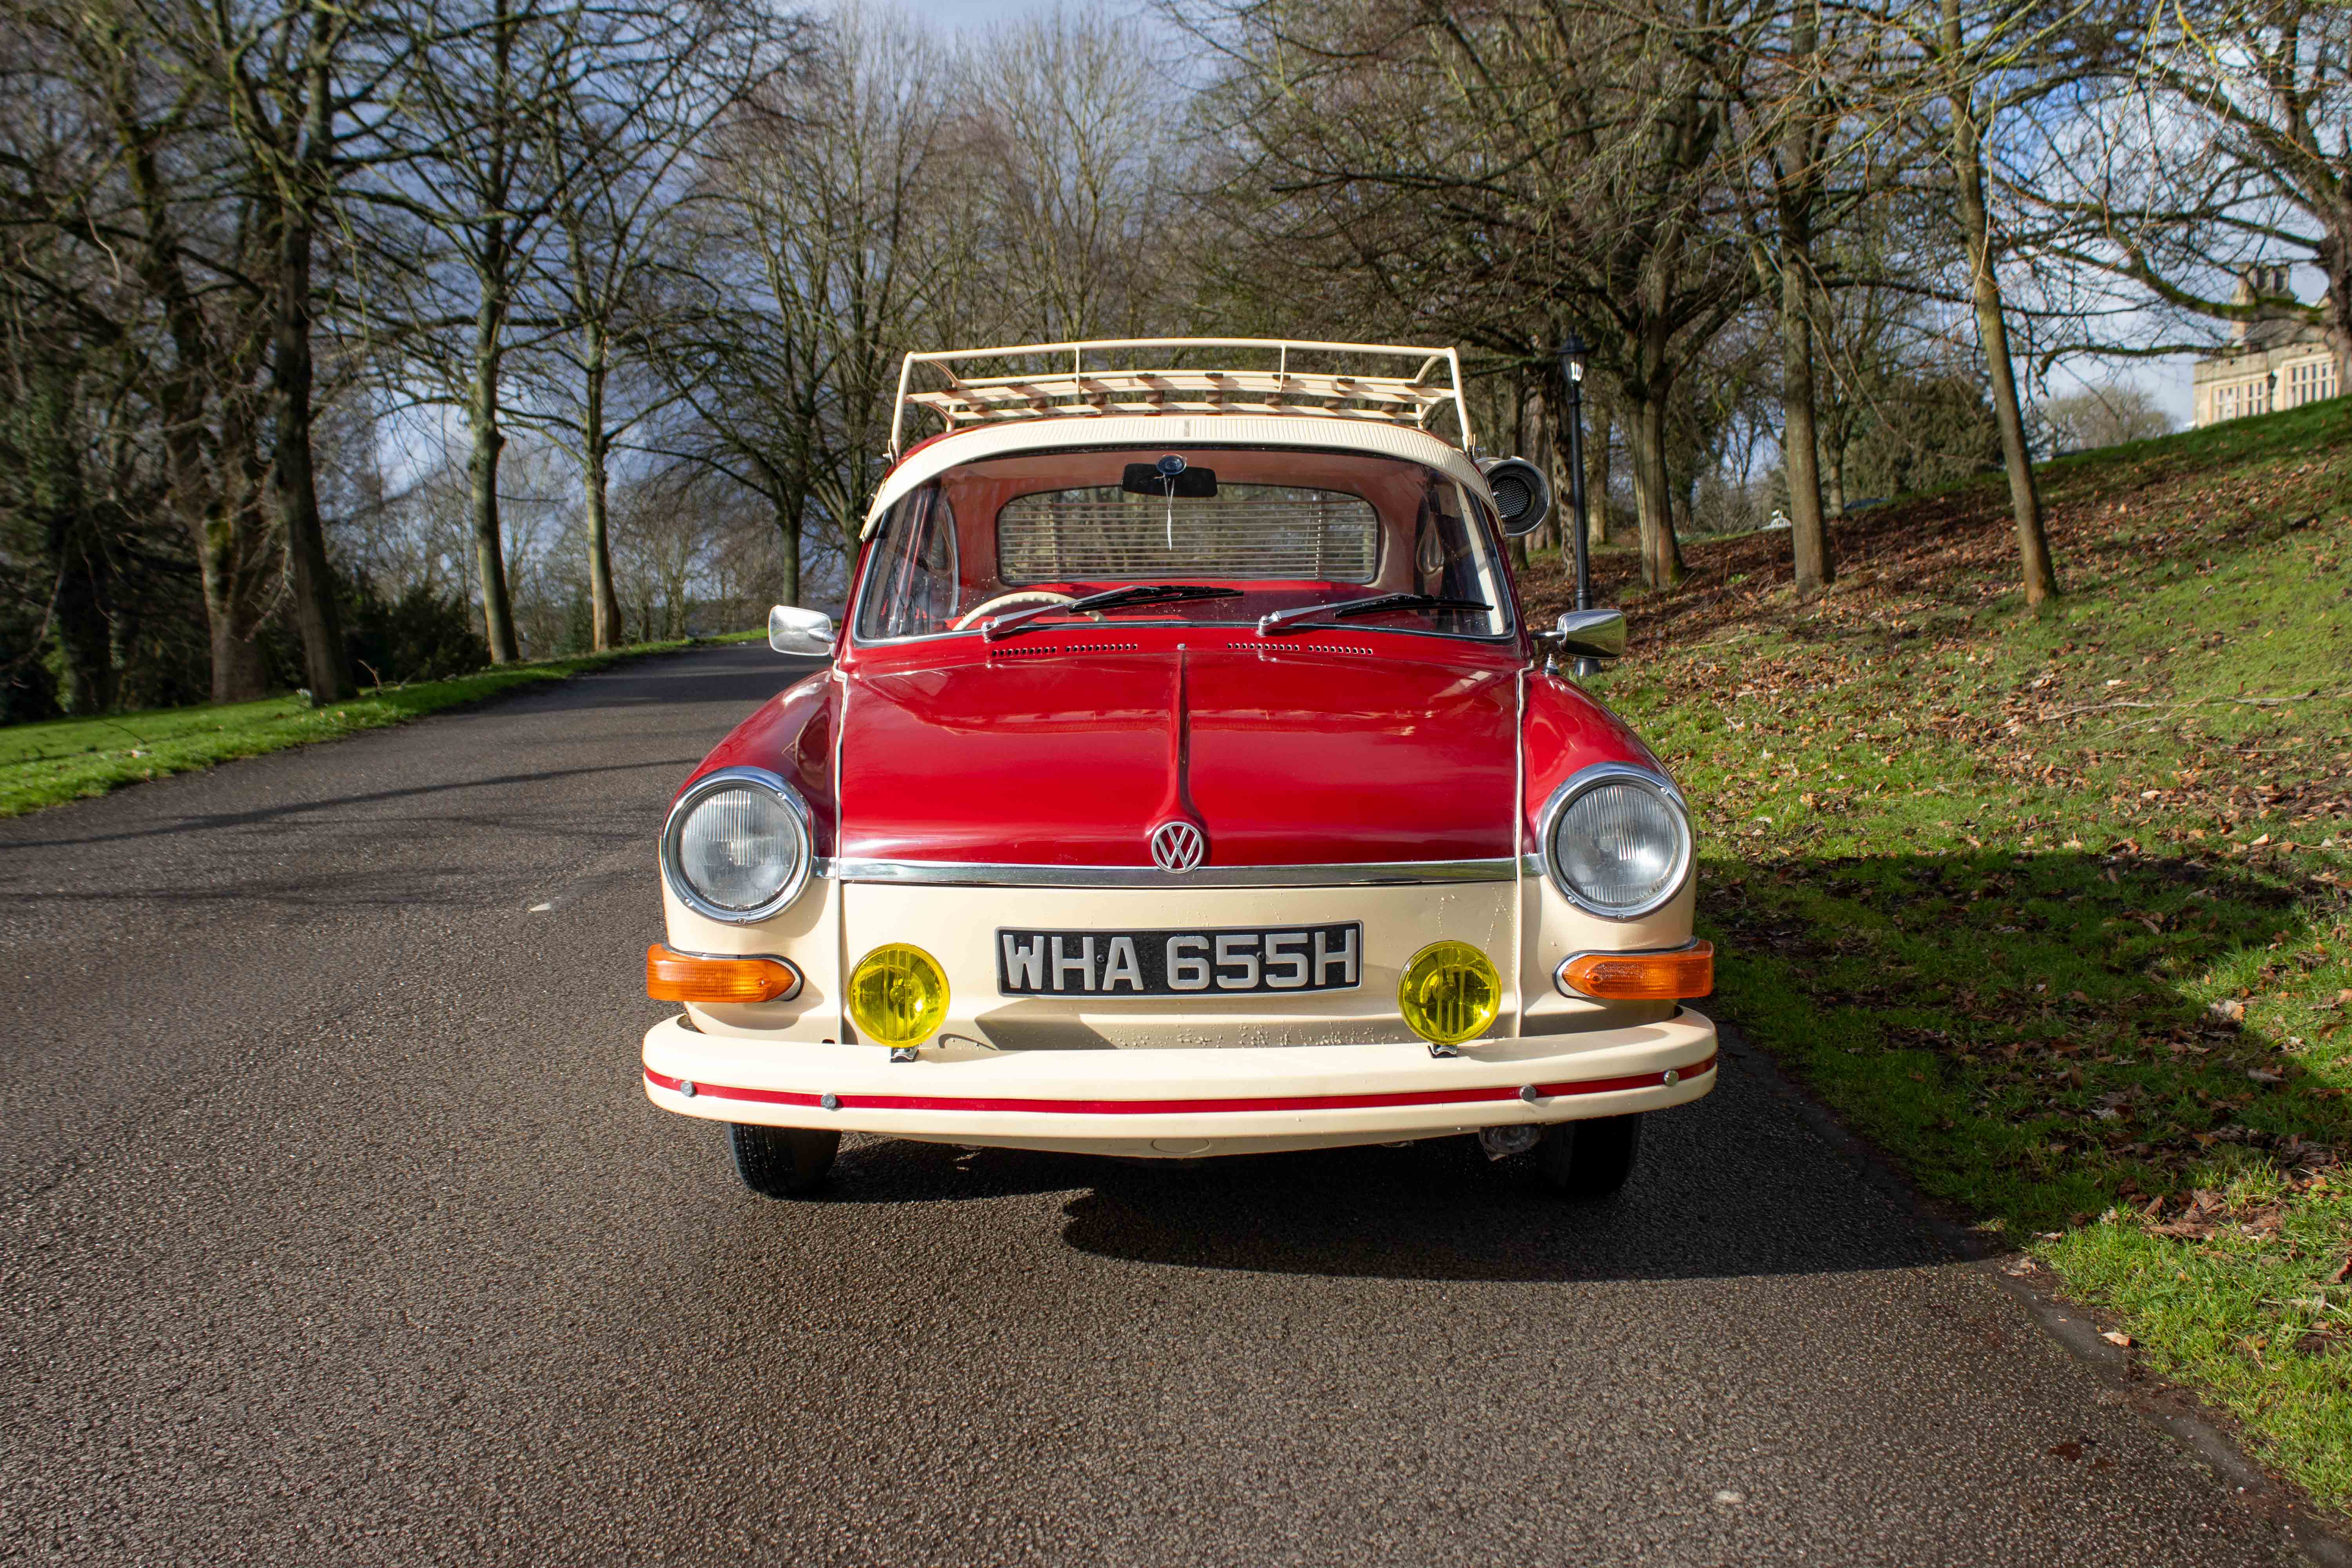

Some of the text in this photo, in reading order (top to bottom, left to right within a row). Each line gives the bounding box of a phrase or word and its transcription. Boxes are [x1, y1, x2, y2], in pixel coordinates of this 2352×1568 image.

[1154, 824, 1200, 870] VW
[1003, 929, 1356, 991] WHA 655H
